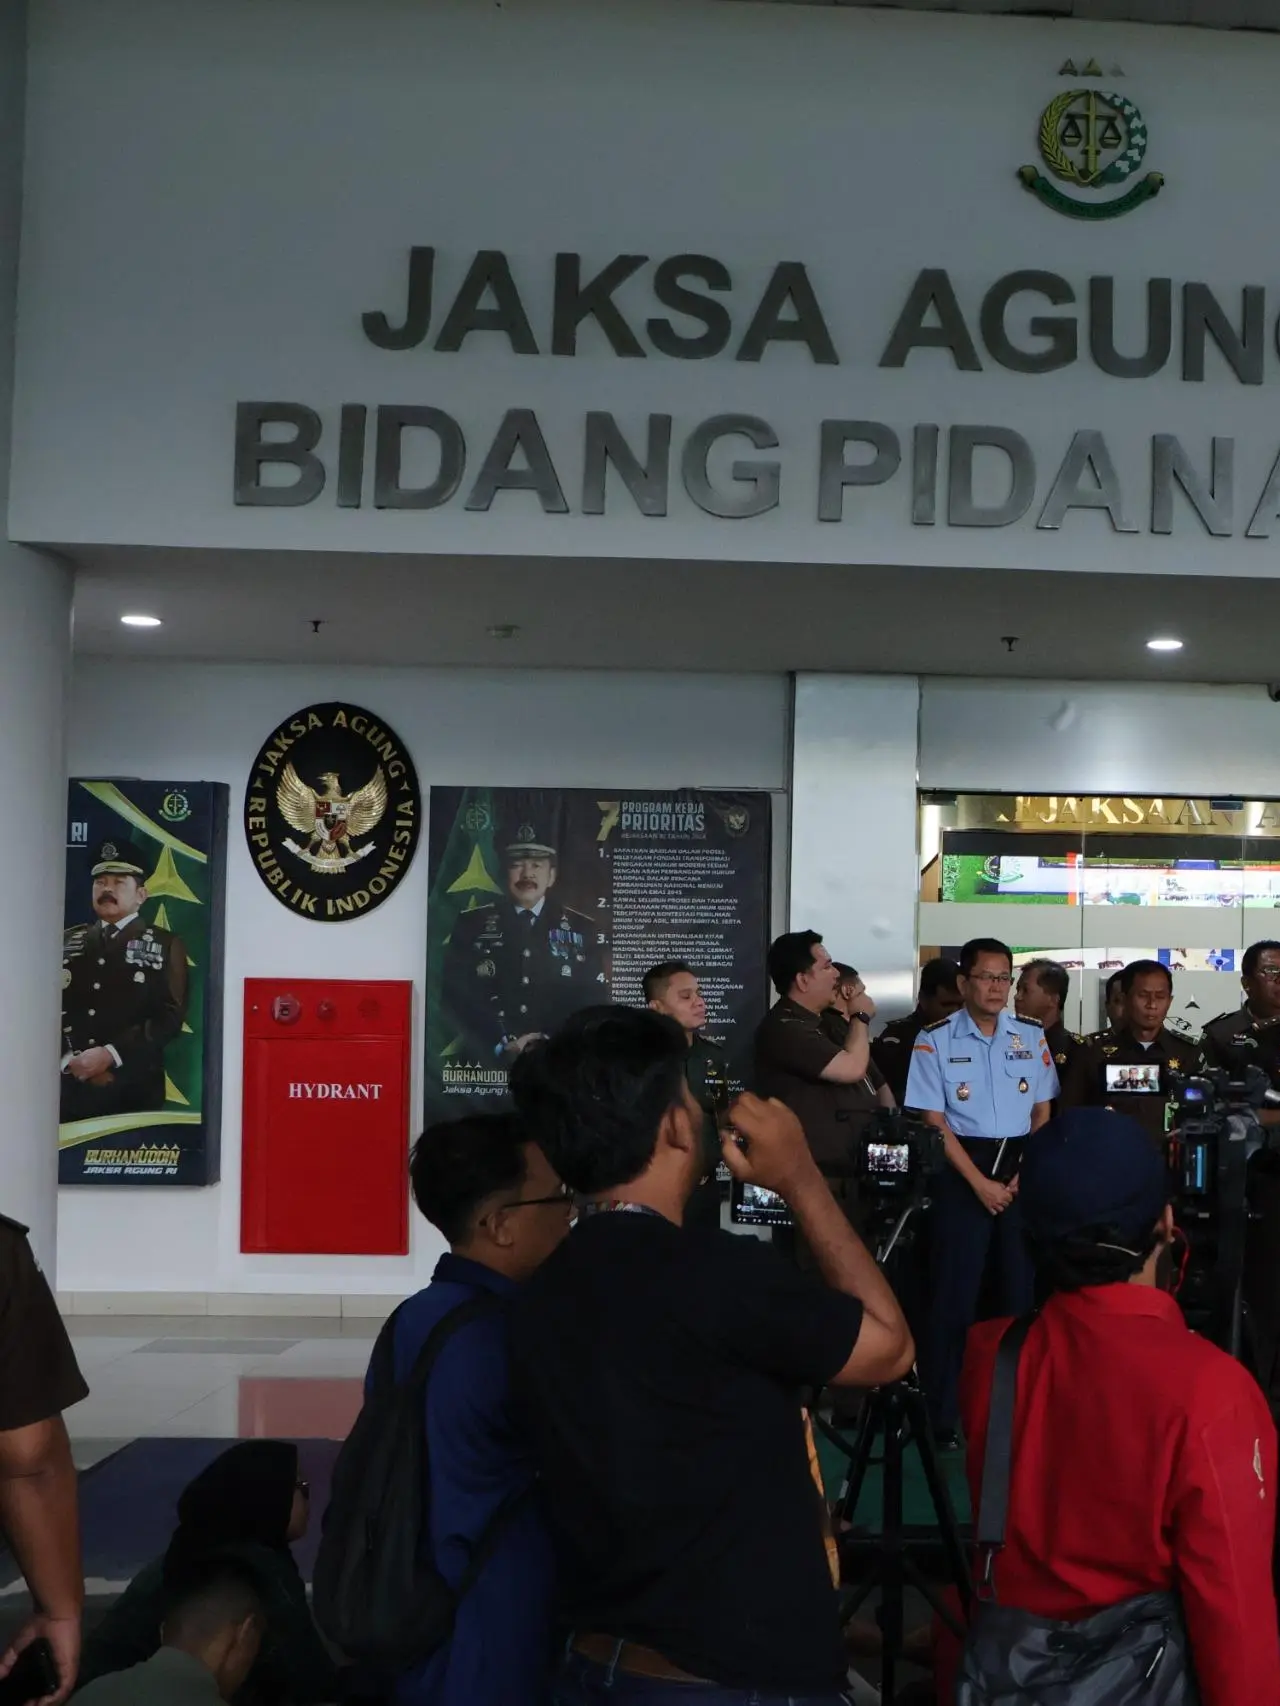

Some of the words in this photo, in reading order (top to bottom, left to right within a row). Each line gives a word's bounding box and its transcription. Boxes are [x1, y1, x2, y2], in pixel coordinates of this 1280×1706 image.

[362, 246, 839, 366] JAKSA
[234, 400, 781, 520] BIDANG
[258, 712, 324, 777] JAKSA
[332, 710, 407, 779] AGUNG
[622, 802, 672, 813] PROGRAM
[675, 802, 705, 814] KERJA
[596, 801, 620, 841] 7
[621, 813, 705, 831] PRIORITAS
[71, 822, 88, 842] RI
[248, 796, 320, 914] REPUBLIK
[326, 799, 414, 916] INDONESIA
[598, 847, 610, 858] 1.
[597, 897, 610, 908] 2.
[597, 933, 609, 944] 3.
[596, 972, 609, 983] 4.
[442, 1070, 509, 1082] BURHANUDDI
[288, 1082, 383, 1100] HYDRANT
[442, 1085, 472, 1094] Jaksa
[473, 1086, 503, 1096] Agung
[85, 1149, 182, 1165] BURHANUDDIN
[84, 1166, 123, 1174] JAKSA
[124, 1166, 164, 1174] AGUNG
[166, 1167, 179, 1175] RI
